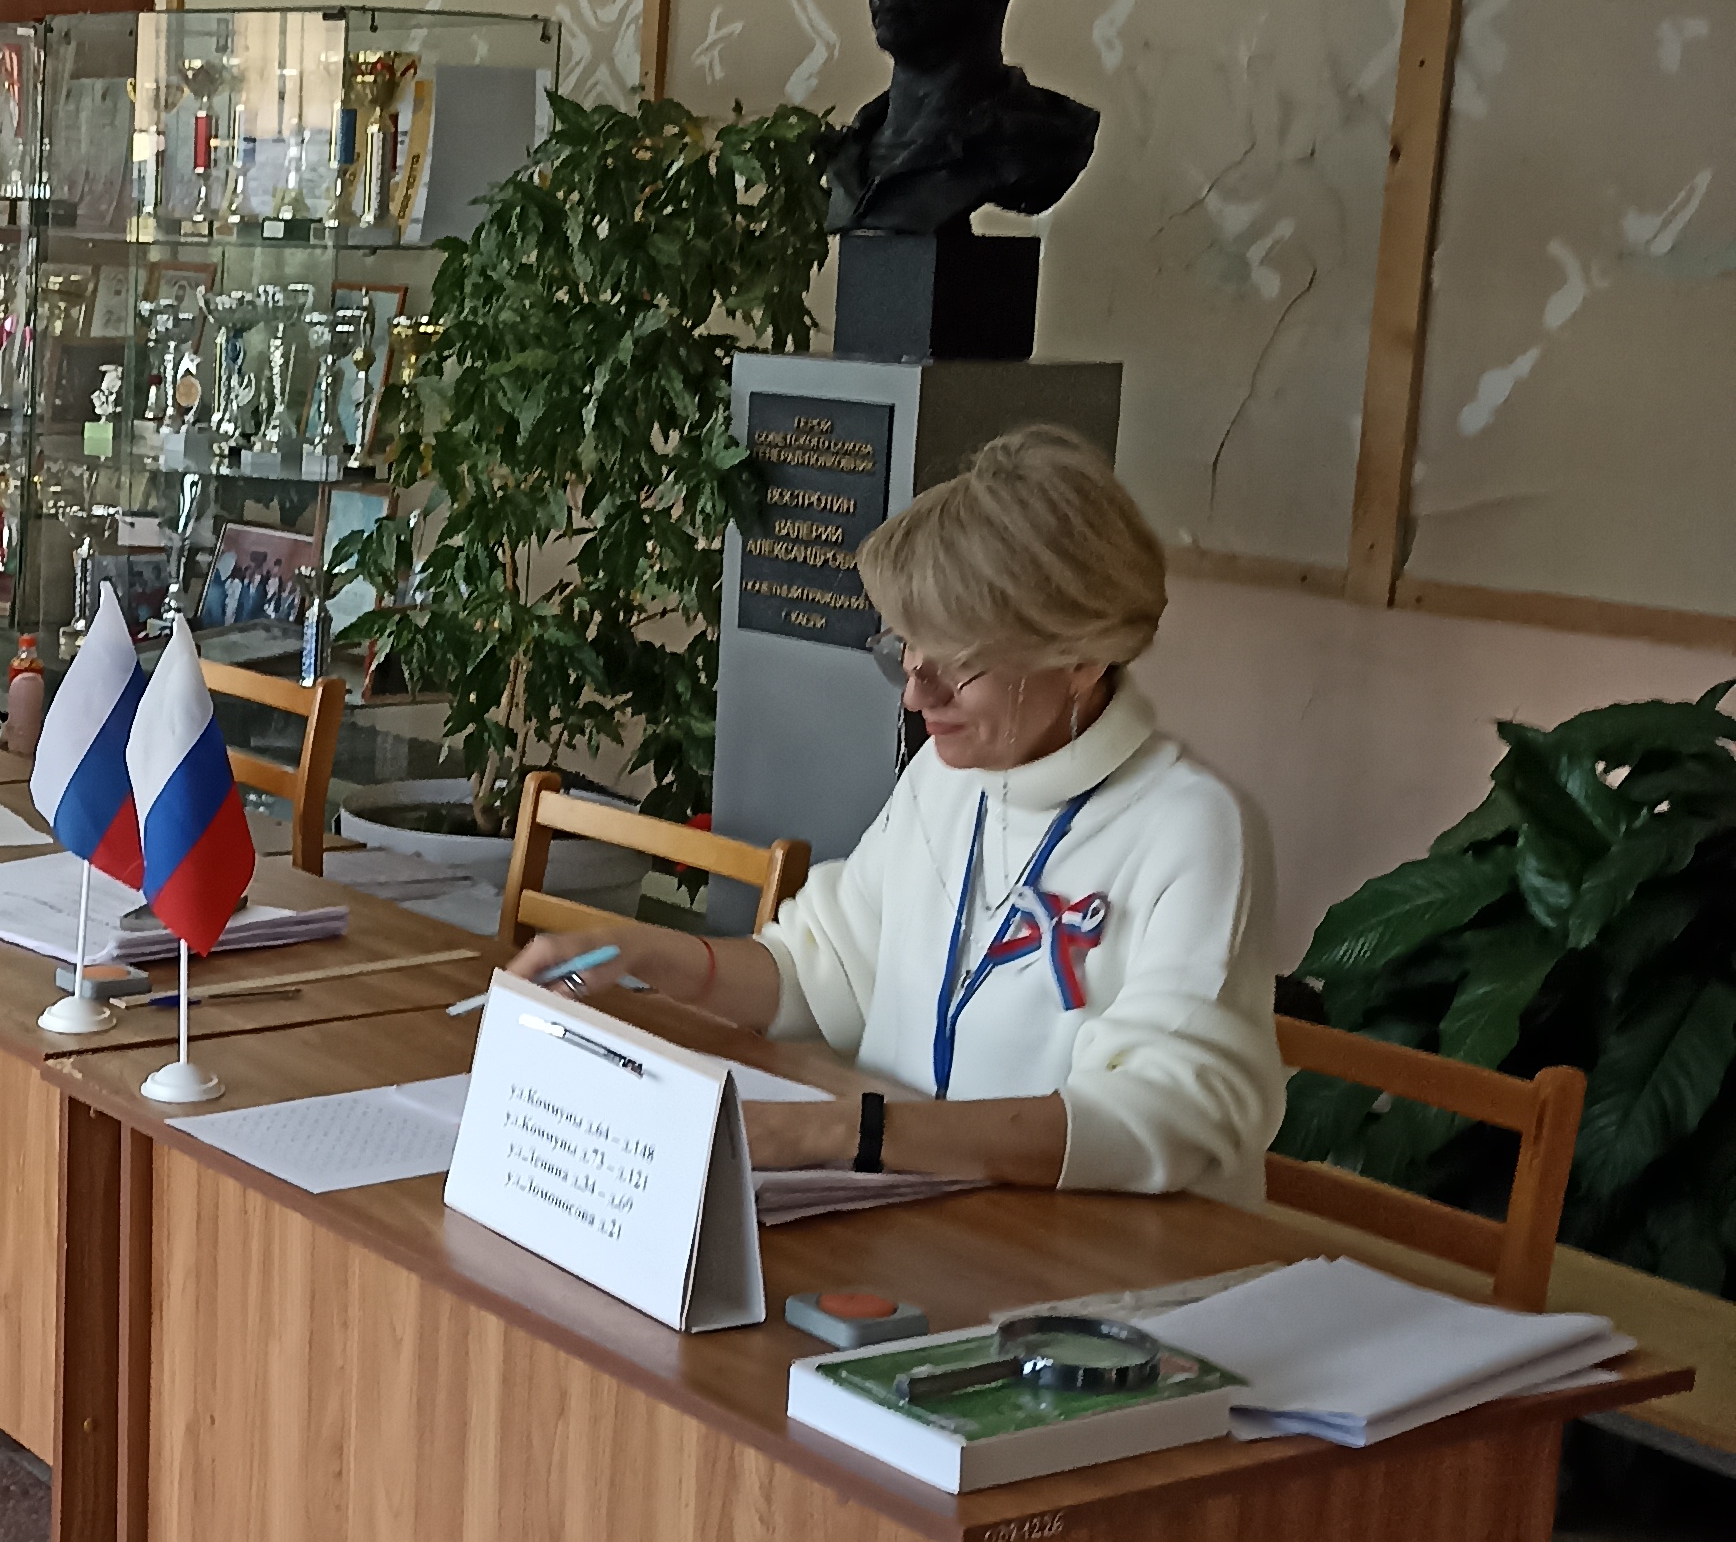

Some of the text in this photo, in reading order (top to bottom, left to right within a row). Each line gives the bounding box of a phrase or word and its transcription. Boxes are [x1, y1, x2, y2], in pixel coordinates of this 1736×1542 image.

[794, 416, 832, 433] ГЕРОЙ
[754, 431, 873, 456] СОВЕТСКОГО СОЮЗА
[767, 486, 856, 514] ВОСТРОТИН
[775, 519, 843, 544] ВАЛЕРИЙ
[746, 538, 858, 570] АЛЕКСАНДРОВИ
[507, 1142, 568, 1183] ул.Ленина
